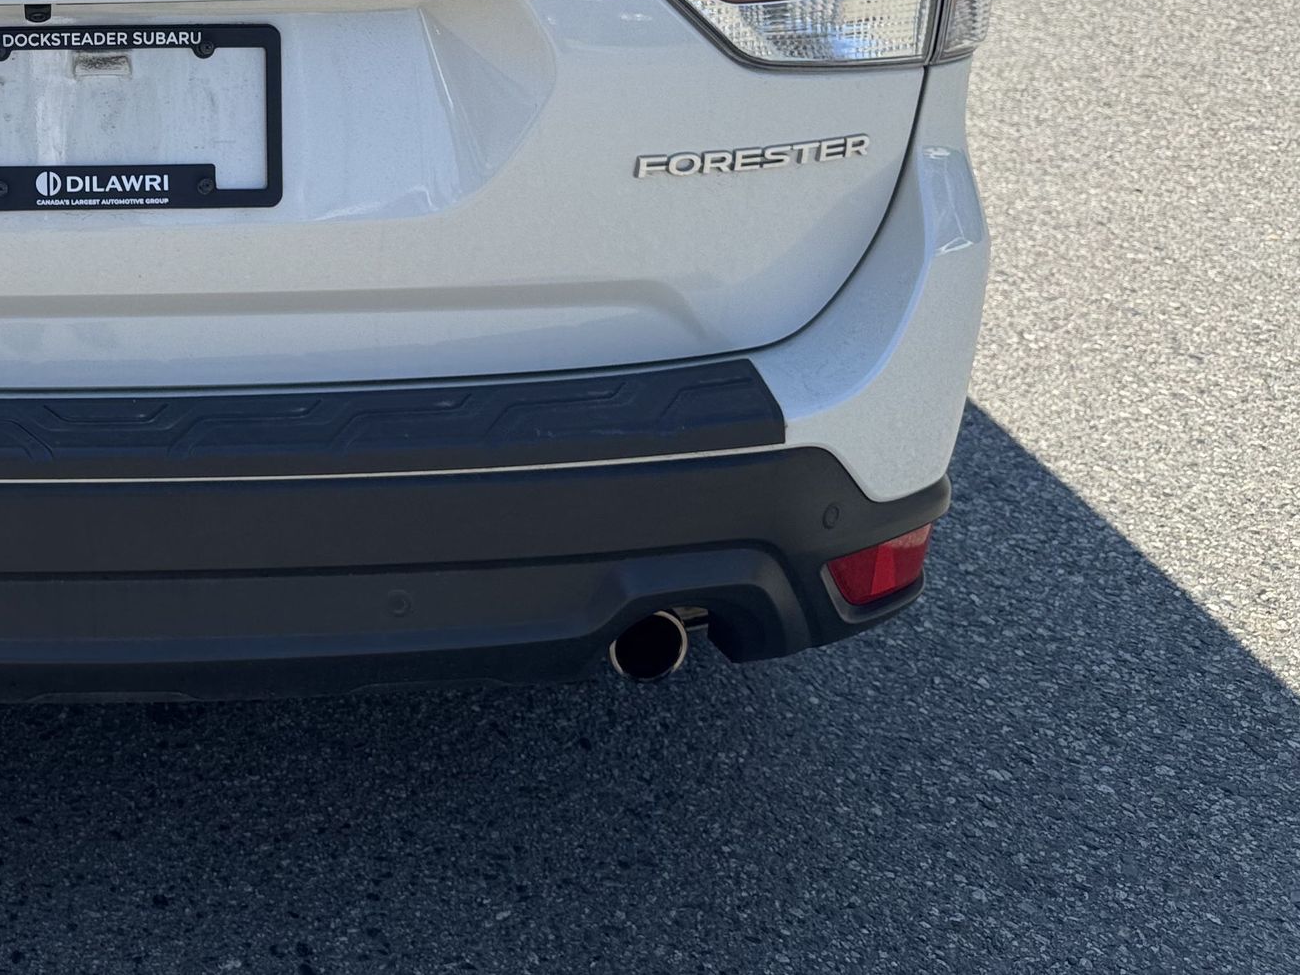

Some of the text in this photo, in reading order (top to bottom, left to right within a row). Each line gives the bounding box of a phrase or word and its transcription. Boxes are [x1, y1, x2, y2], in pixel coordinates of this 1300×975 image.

[2, 31, 202, 48] DOCKSTEADER SUBARU
[635, 133, 870, 178] FORESTER
[66, 174, 170, 193] DILAWRI
